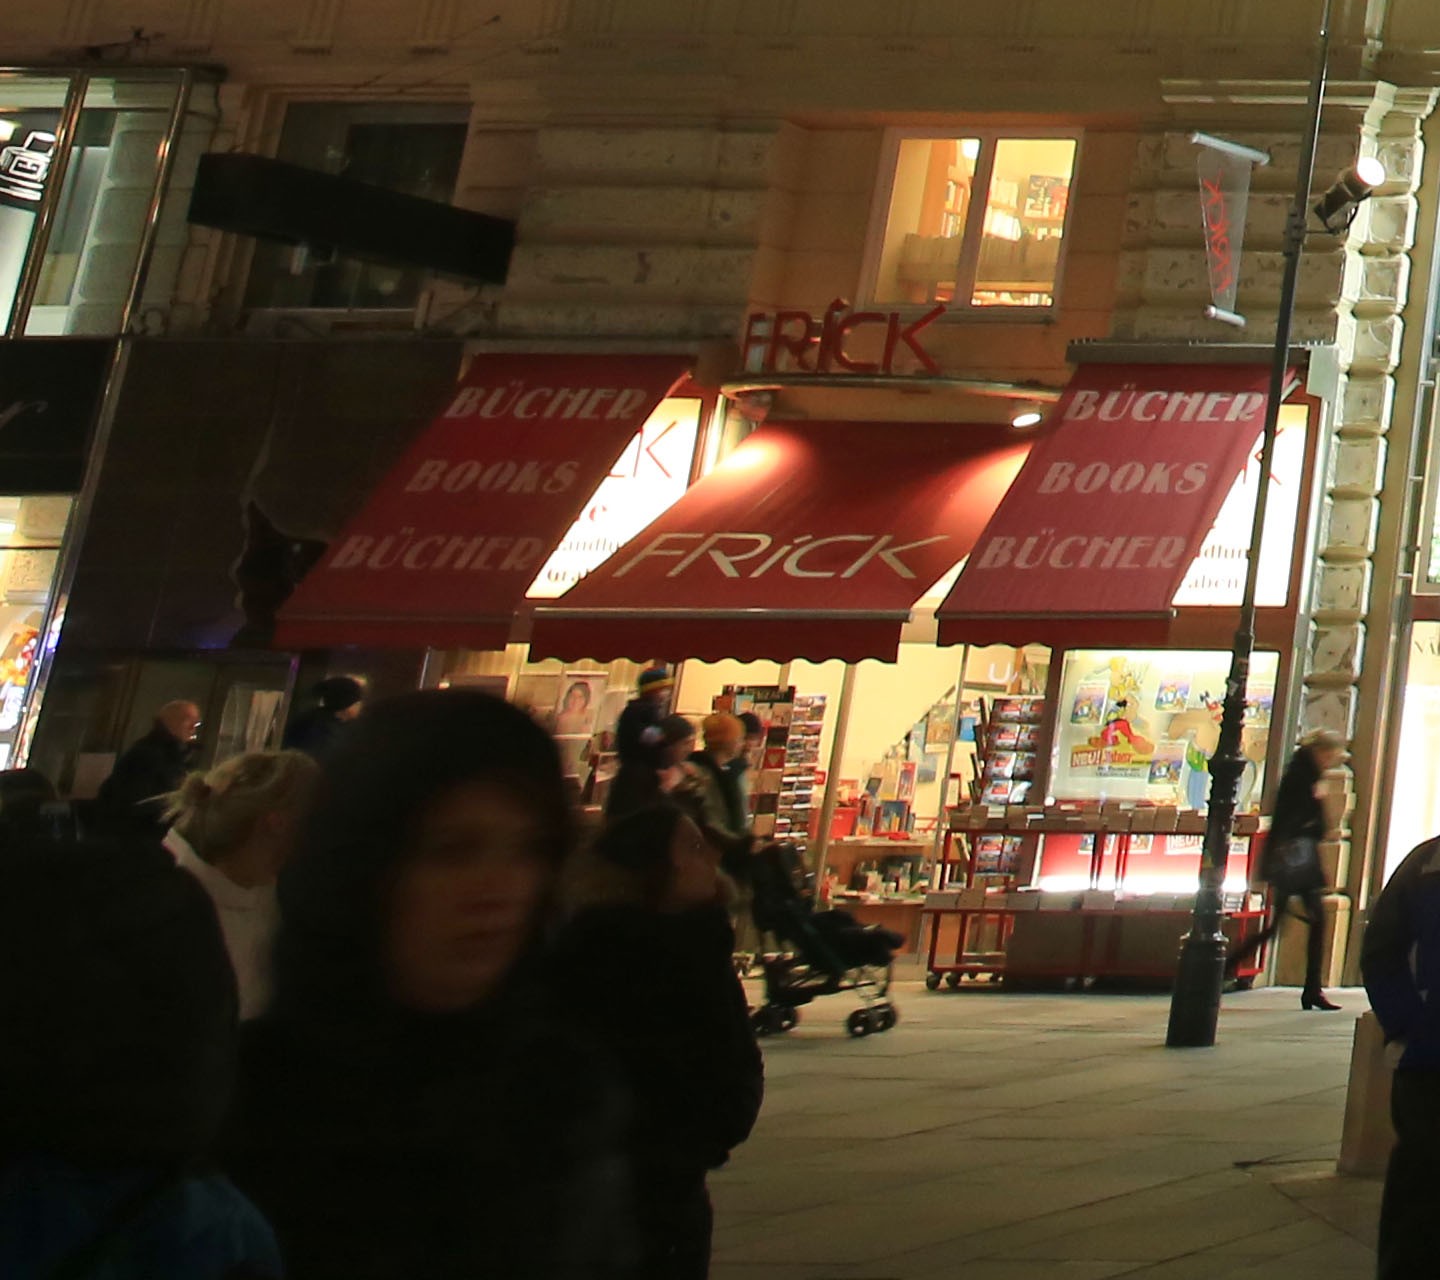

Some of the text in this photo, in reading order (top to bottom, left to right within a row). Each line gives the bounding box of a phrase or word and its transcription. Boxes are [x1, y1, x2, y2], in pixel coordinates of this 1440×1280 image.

[443, 378, 648, 420] BÜCHER
[1063, 383, 1266, 423] BÜCHER
[405, 459, 581, 495] BOOKS
[1036, 461, 1210, 495] BOOKS
[328, 526, 547, 571] BÜCHER
[976, 527, 1187, 570] BÜCHER
